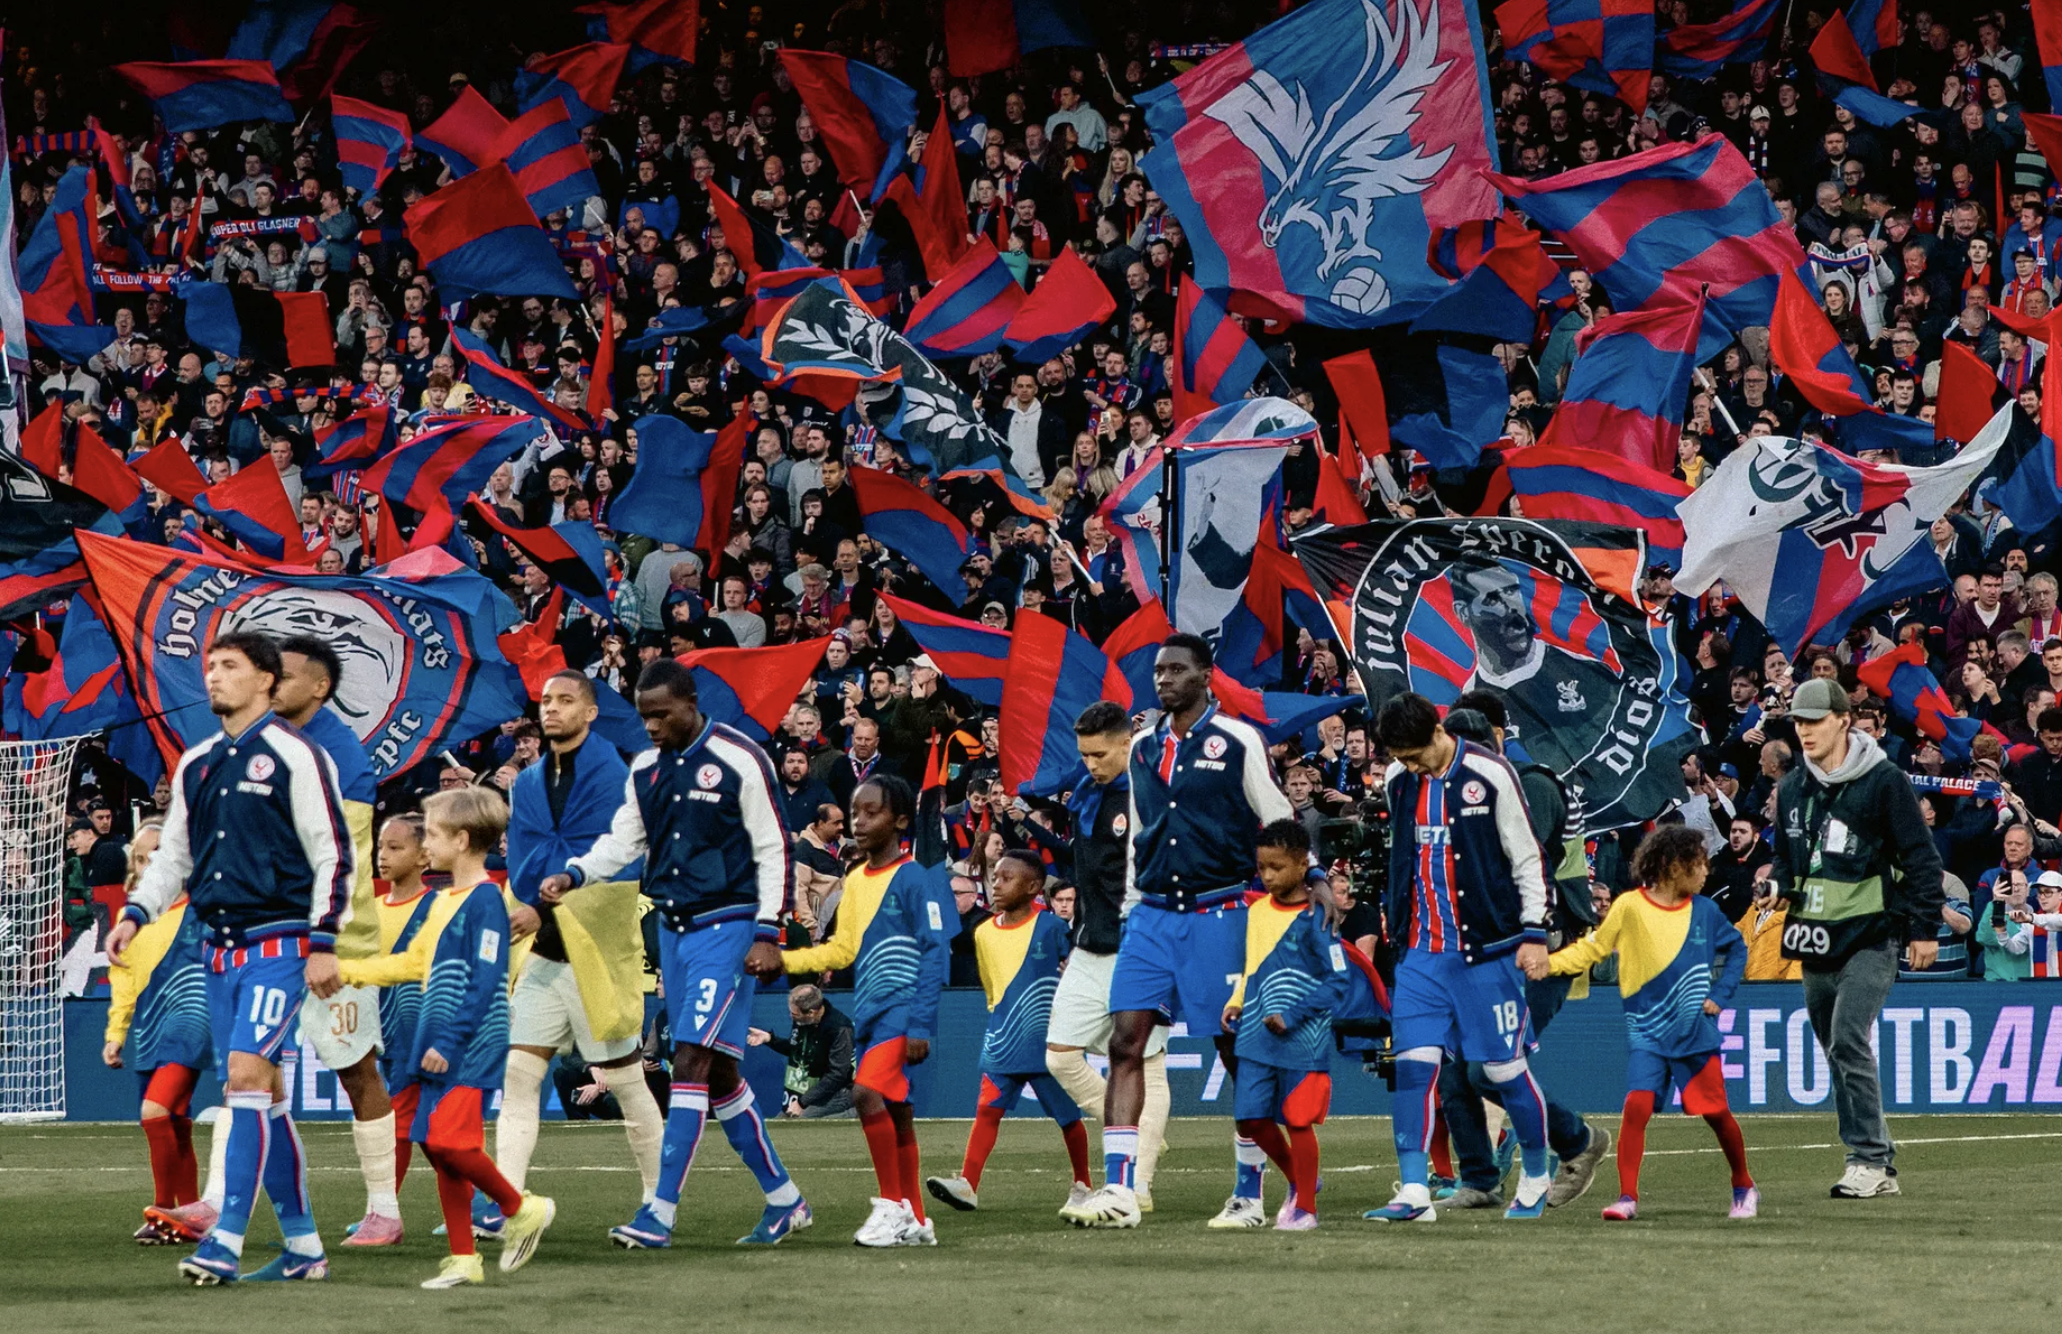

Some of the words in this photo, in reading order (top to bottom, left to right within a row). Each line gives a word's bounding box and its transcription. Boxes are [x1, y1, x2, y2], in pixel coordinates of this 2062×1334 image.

[257, 218, 301, 230] GLASNER
[109, 274, 143, 285] FOLLOW
[1932, 776, 1982, 791] PALACE
[1783, 923, 1831, 955] 029
[250, 985, 287, 1026] 10
[695, 977, 718, 1013] 3
[329, 1001, 359, 1036] 30
[1492, 1000, 1519, 1035] 18
